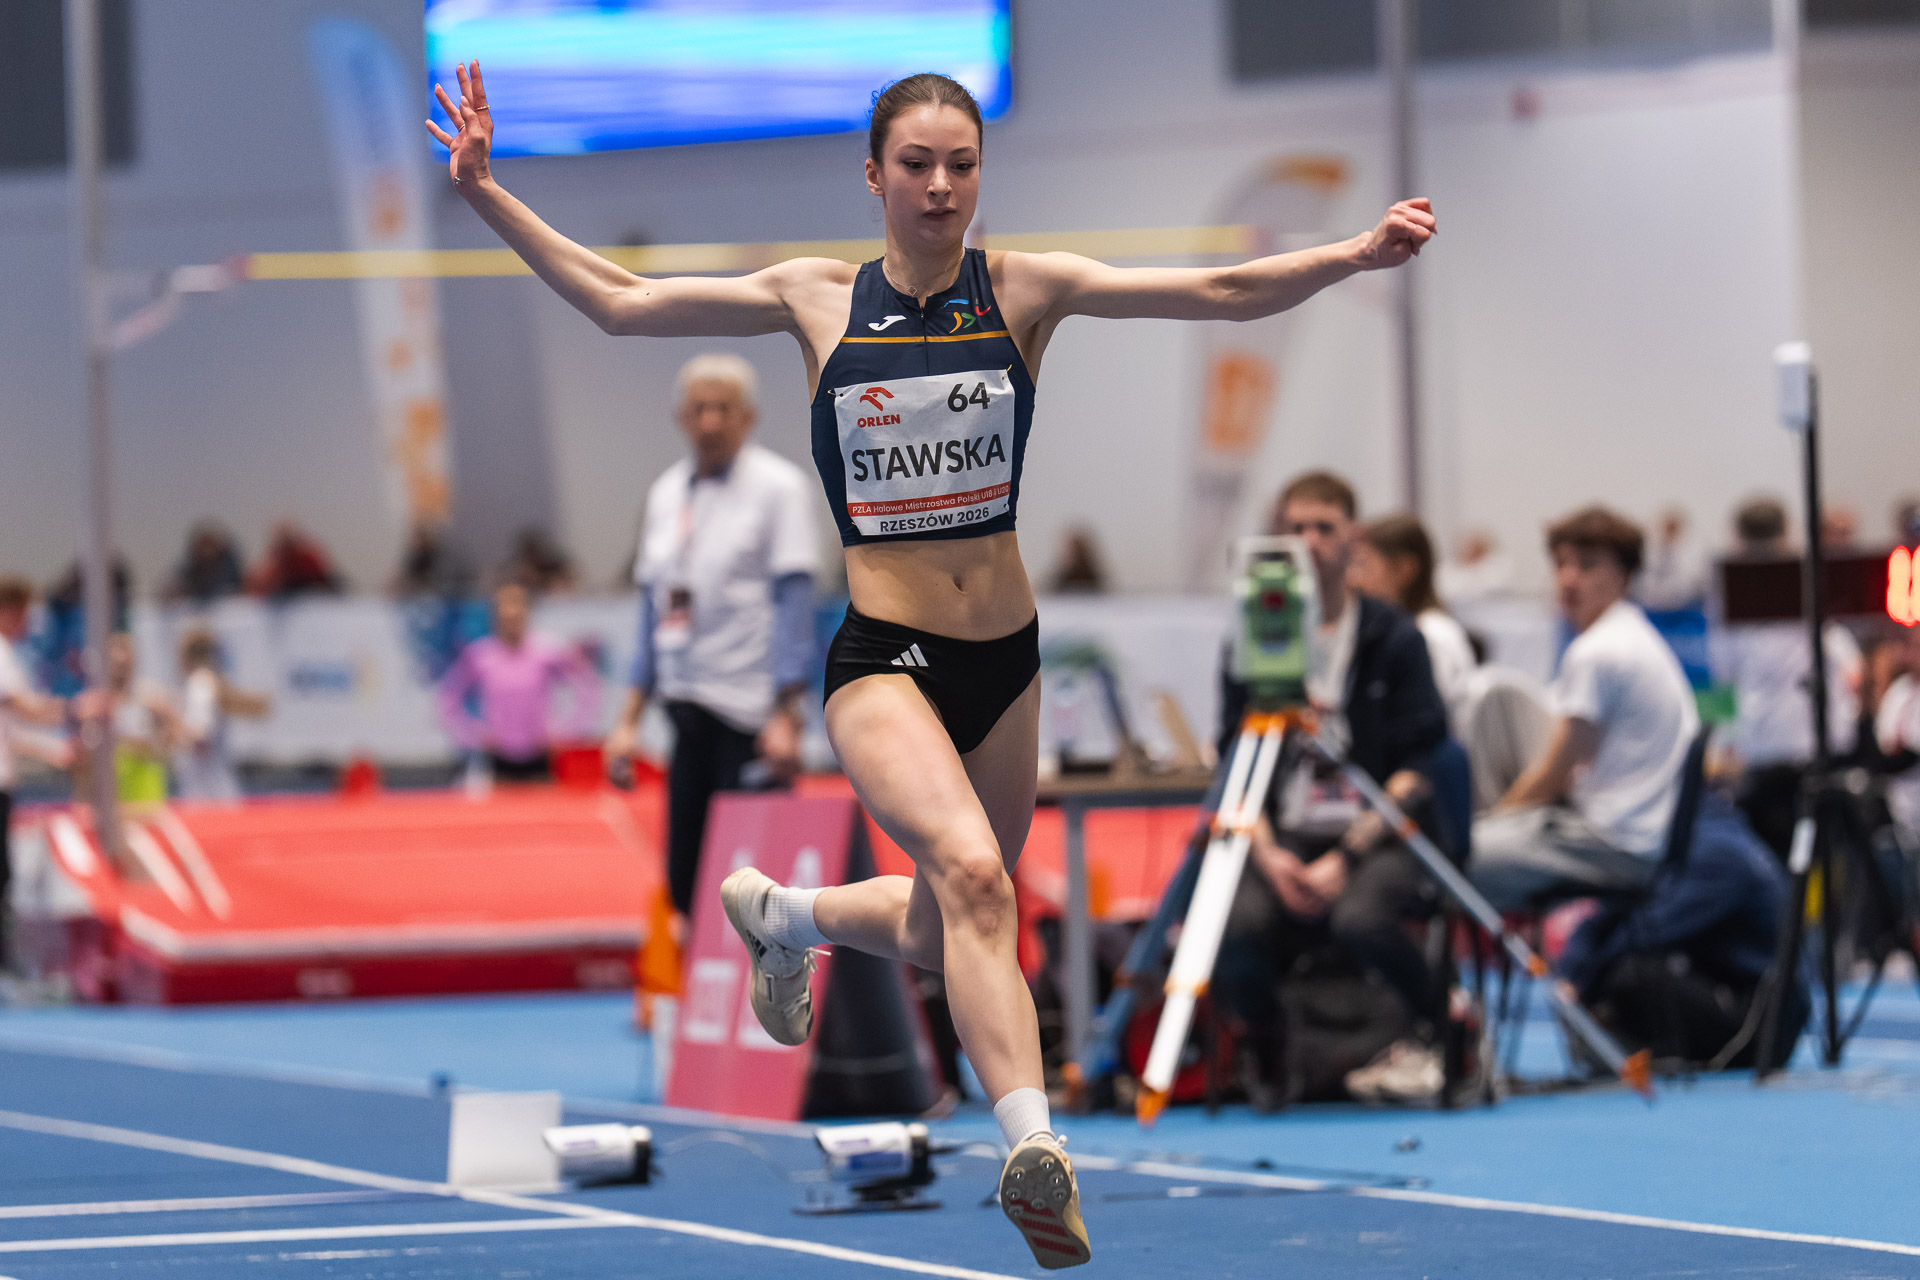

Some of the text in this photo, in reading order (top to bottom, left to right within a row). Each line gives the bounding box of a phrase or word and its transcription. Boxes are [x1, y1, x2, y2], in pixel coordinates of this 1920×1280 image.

[947, 382, 991, 413] 64
[857, 413, 901, 428] ORLEN
[851, 433, 1006, 482] STAWSKA
[852, 505, 872, 514] PZLA
[873, 504, 903, 513] Halowe
[905, 497, 956, 511] Mistrzostwa
[957, 493, 980, 504] Polski
[981, 489, 993, 500] U18
[880, 506, 990, 533] RZESZÓW 2026
